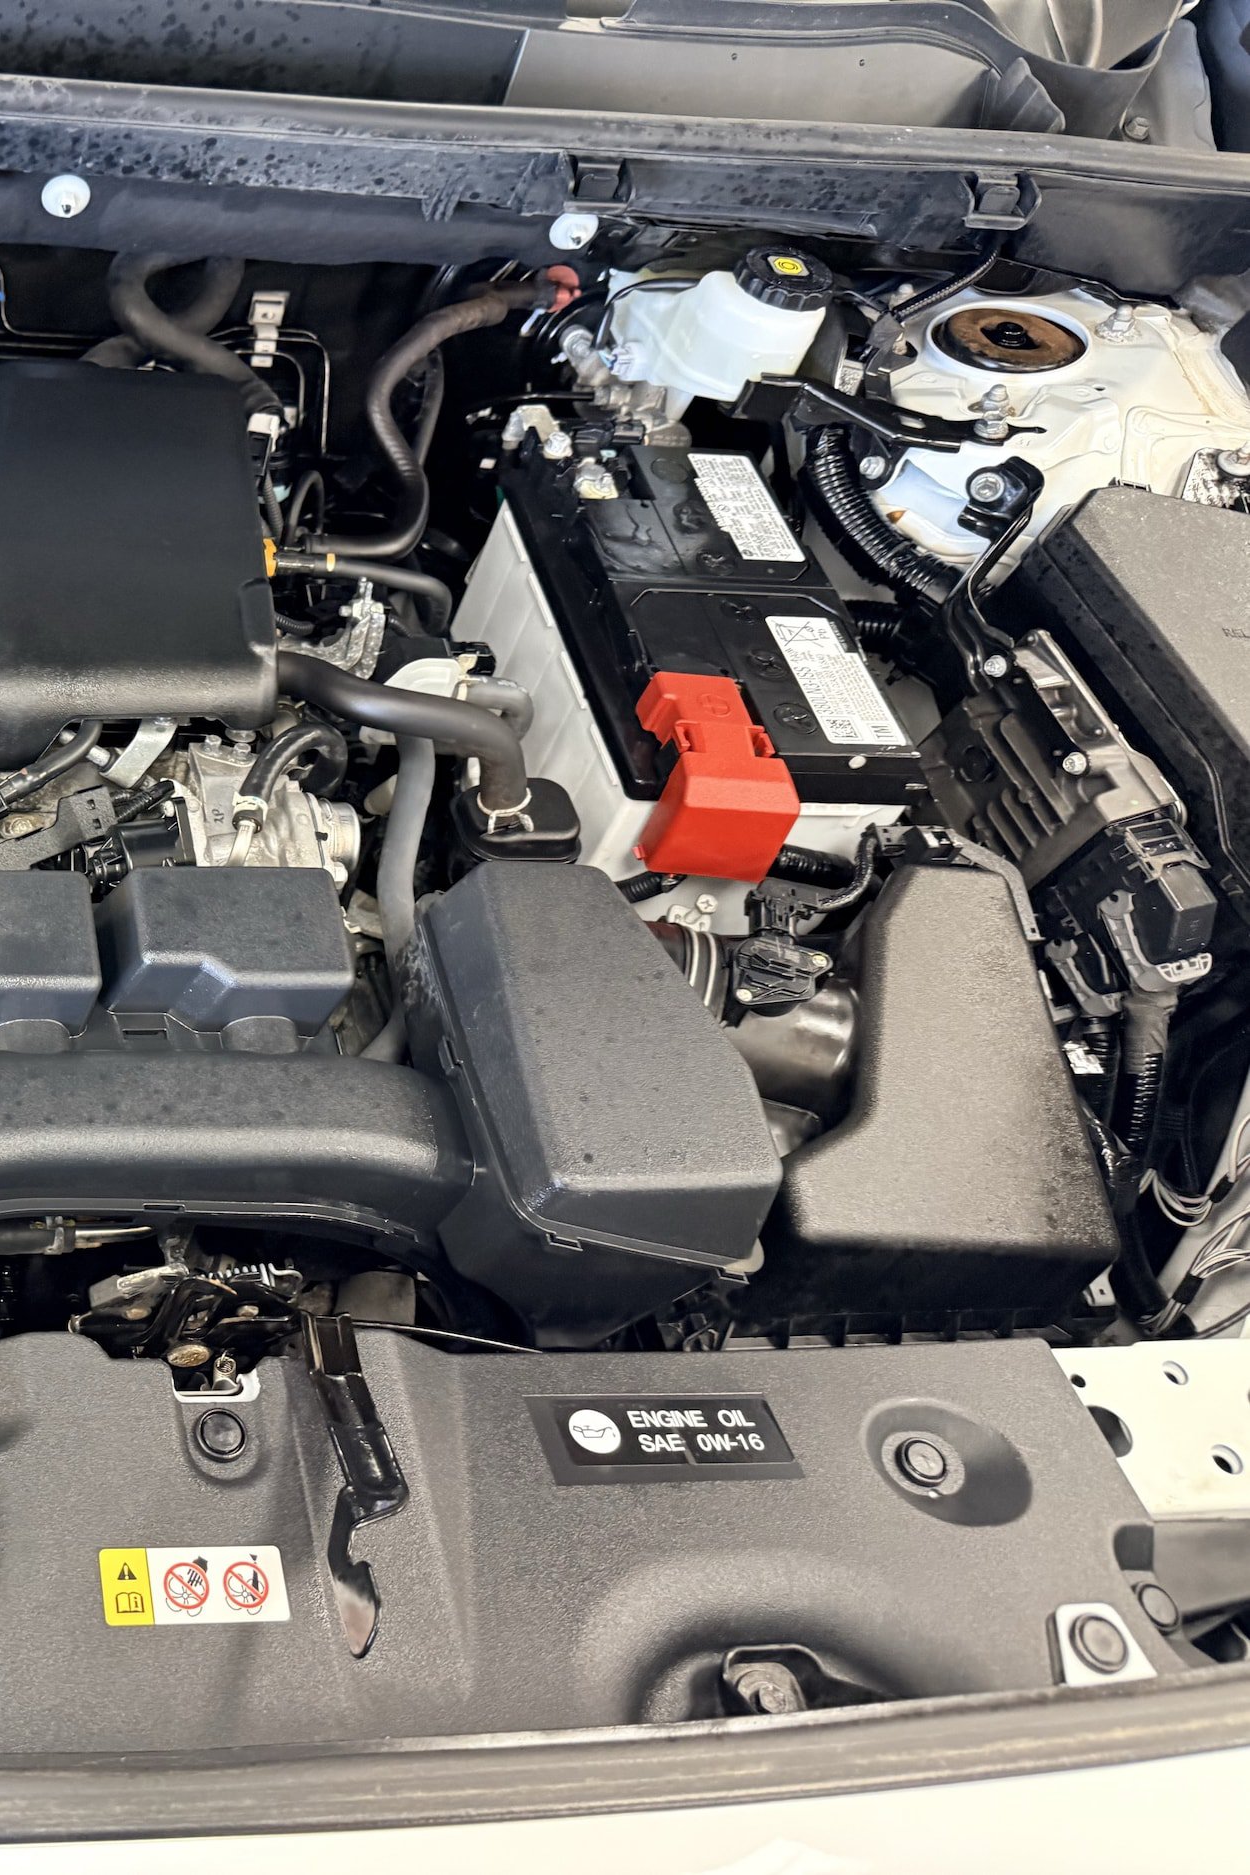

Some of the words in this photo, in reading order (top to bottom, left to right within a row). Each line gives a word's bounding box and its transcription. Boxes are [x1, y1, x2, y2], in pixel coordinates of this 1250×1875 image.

[626, 1410, 708, 1428] ENGINE
[717, 1409, 756, 1428] OIL
[638, 1434, 686, 1452] SAE
[696, 1433, 766, 1452] 0W-16
